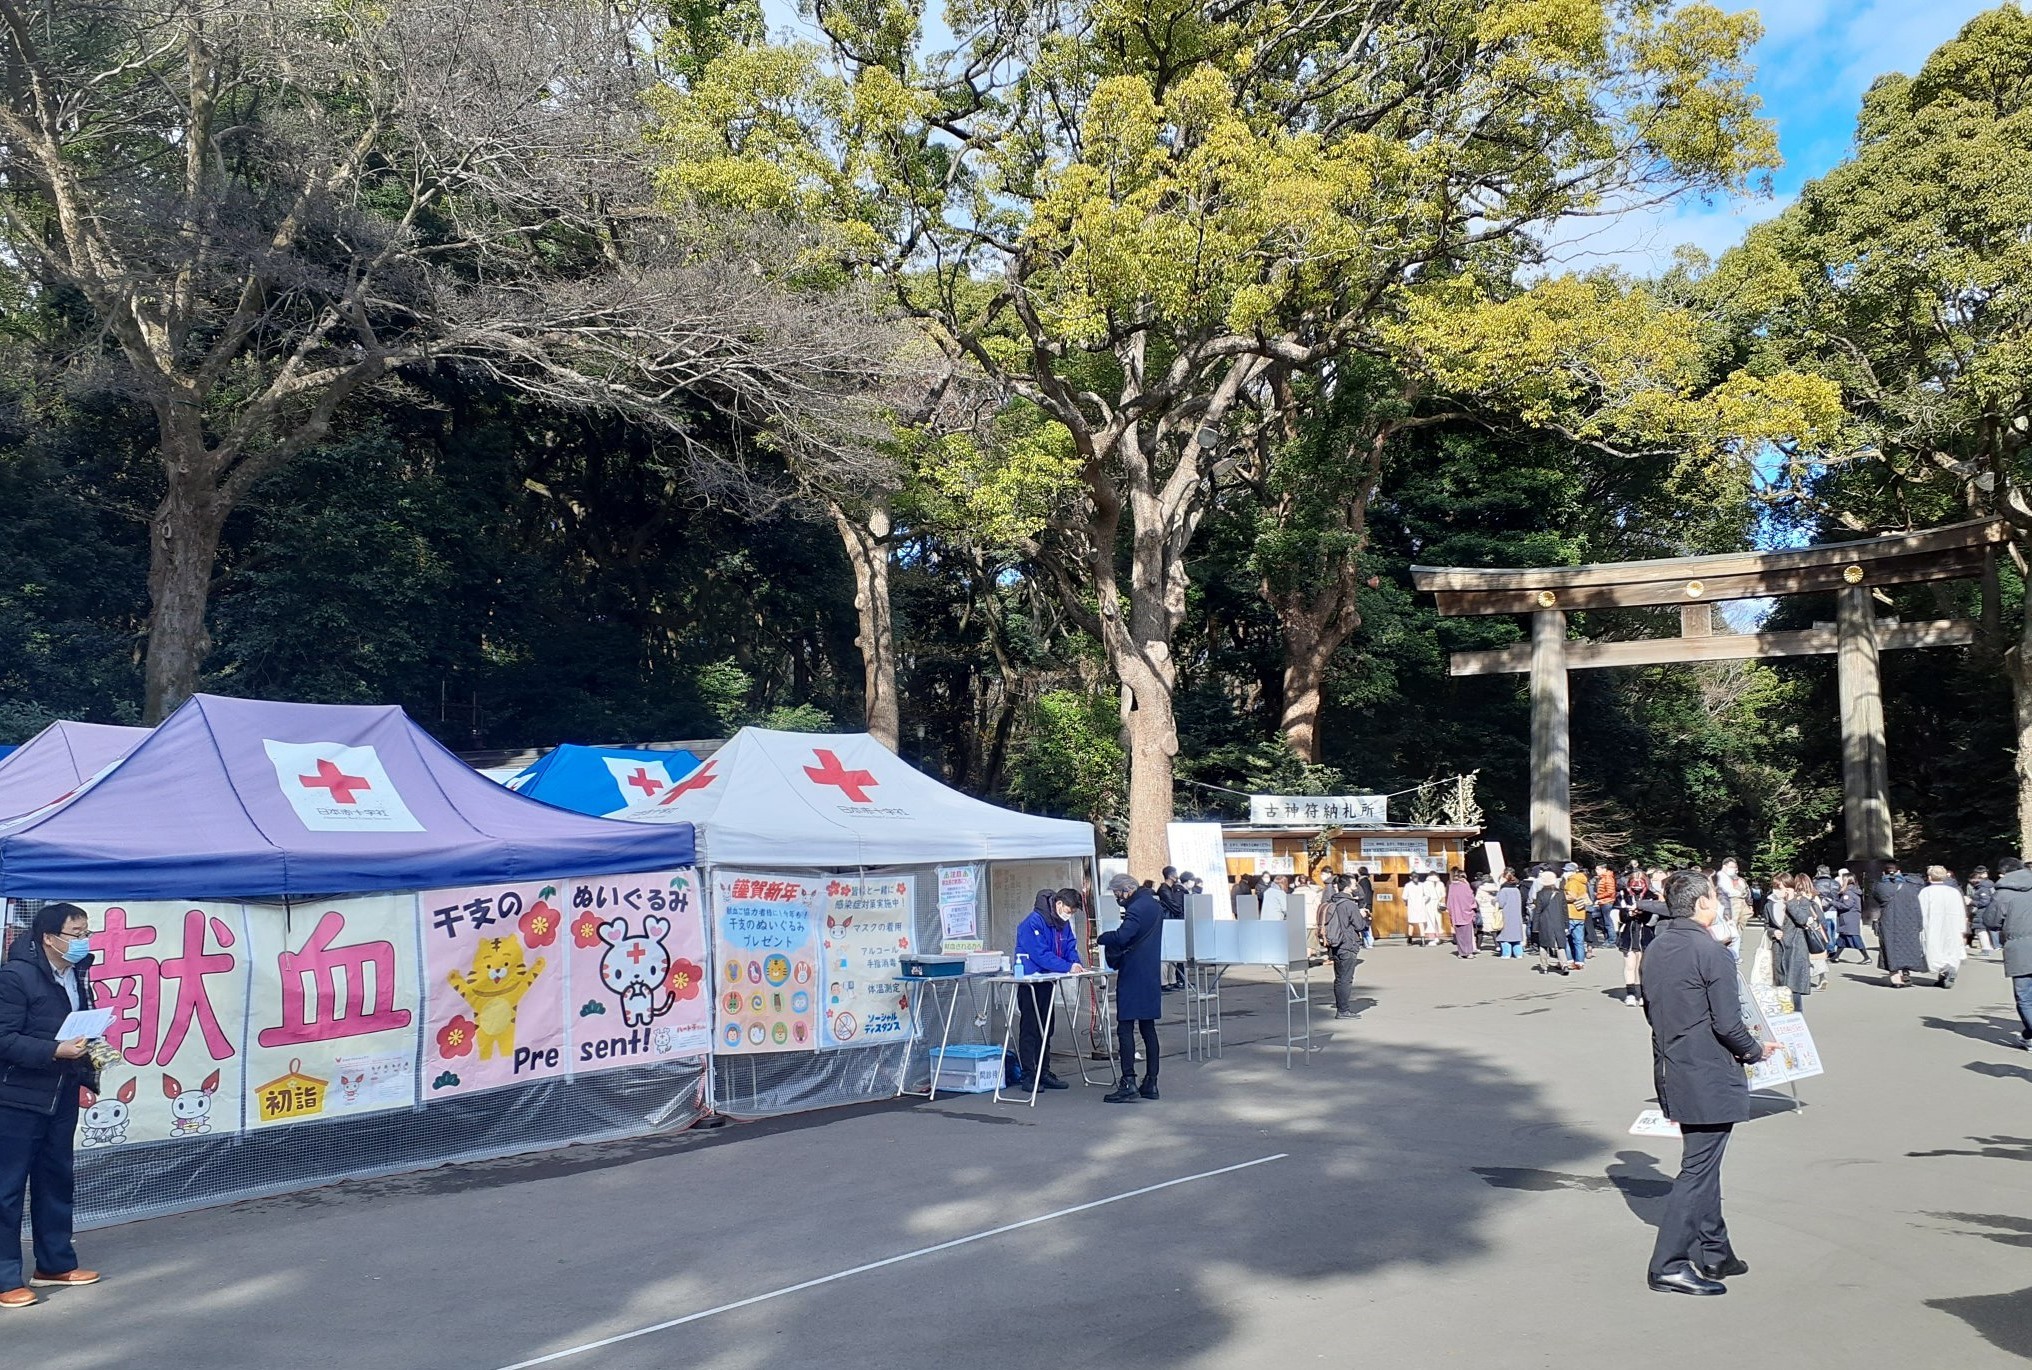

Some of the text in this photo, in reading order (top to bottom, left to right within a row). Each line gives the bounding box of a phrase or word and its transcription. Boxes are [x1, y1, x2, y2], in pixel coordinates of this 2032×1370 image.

[1264, 802, 1375, 819] 古神符納札所
[732, 879, 801, 902] 謹賀新年
[433, 885, 689, 938] 干支の ぬいぐるみ
[729, 918, 805, 932] 干支のぬいぐるみ
[853, 922, 902, 932] マスクの着用
[743, 935, 792, 948] プレゼント
[861, 946, 899, 955] アルコール
[867, 958, 897, 968] 手指消毒
[868, 983, 900, 994] 体温測定
[868, 1012, 897, 1023] ソーシャル
[864, 1021, 901, 1034] ディスタンス
[514, 1046, 559, 1075] Pre
[580, 1027, 650, 1062] sent!
[266, 1086, 318, 1115] 初詣
